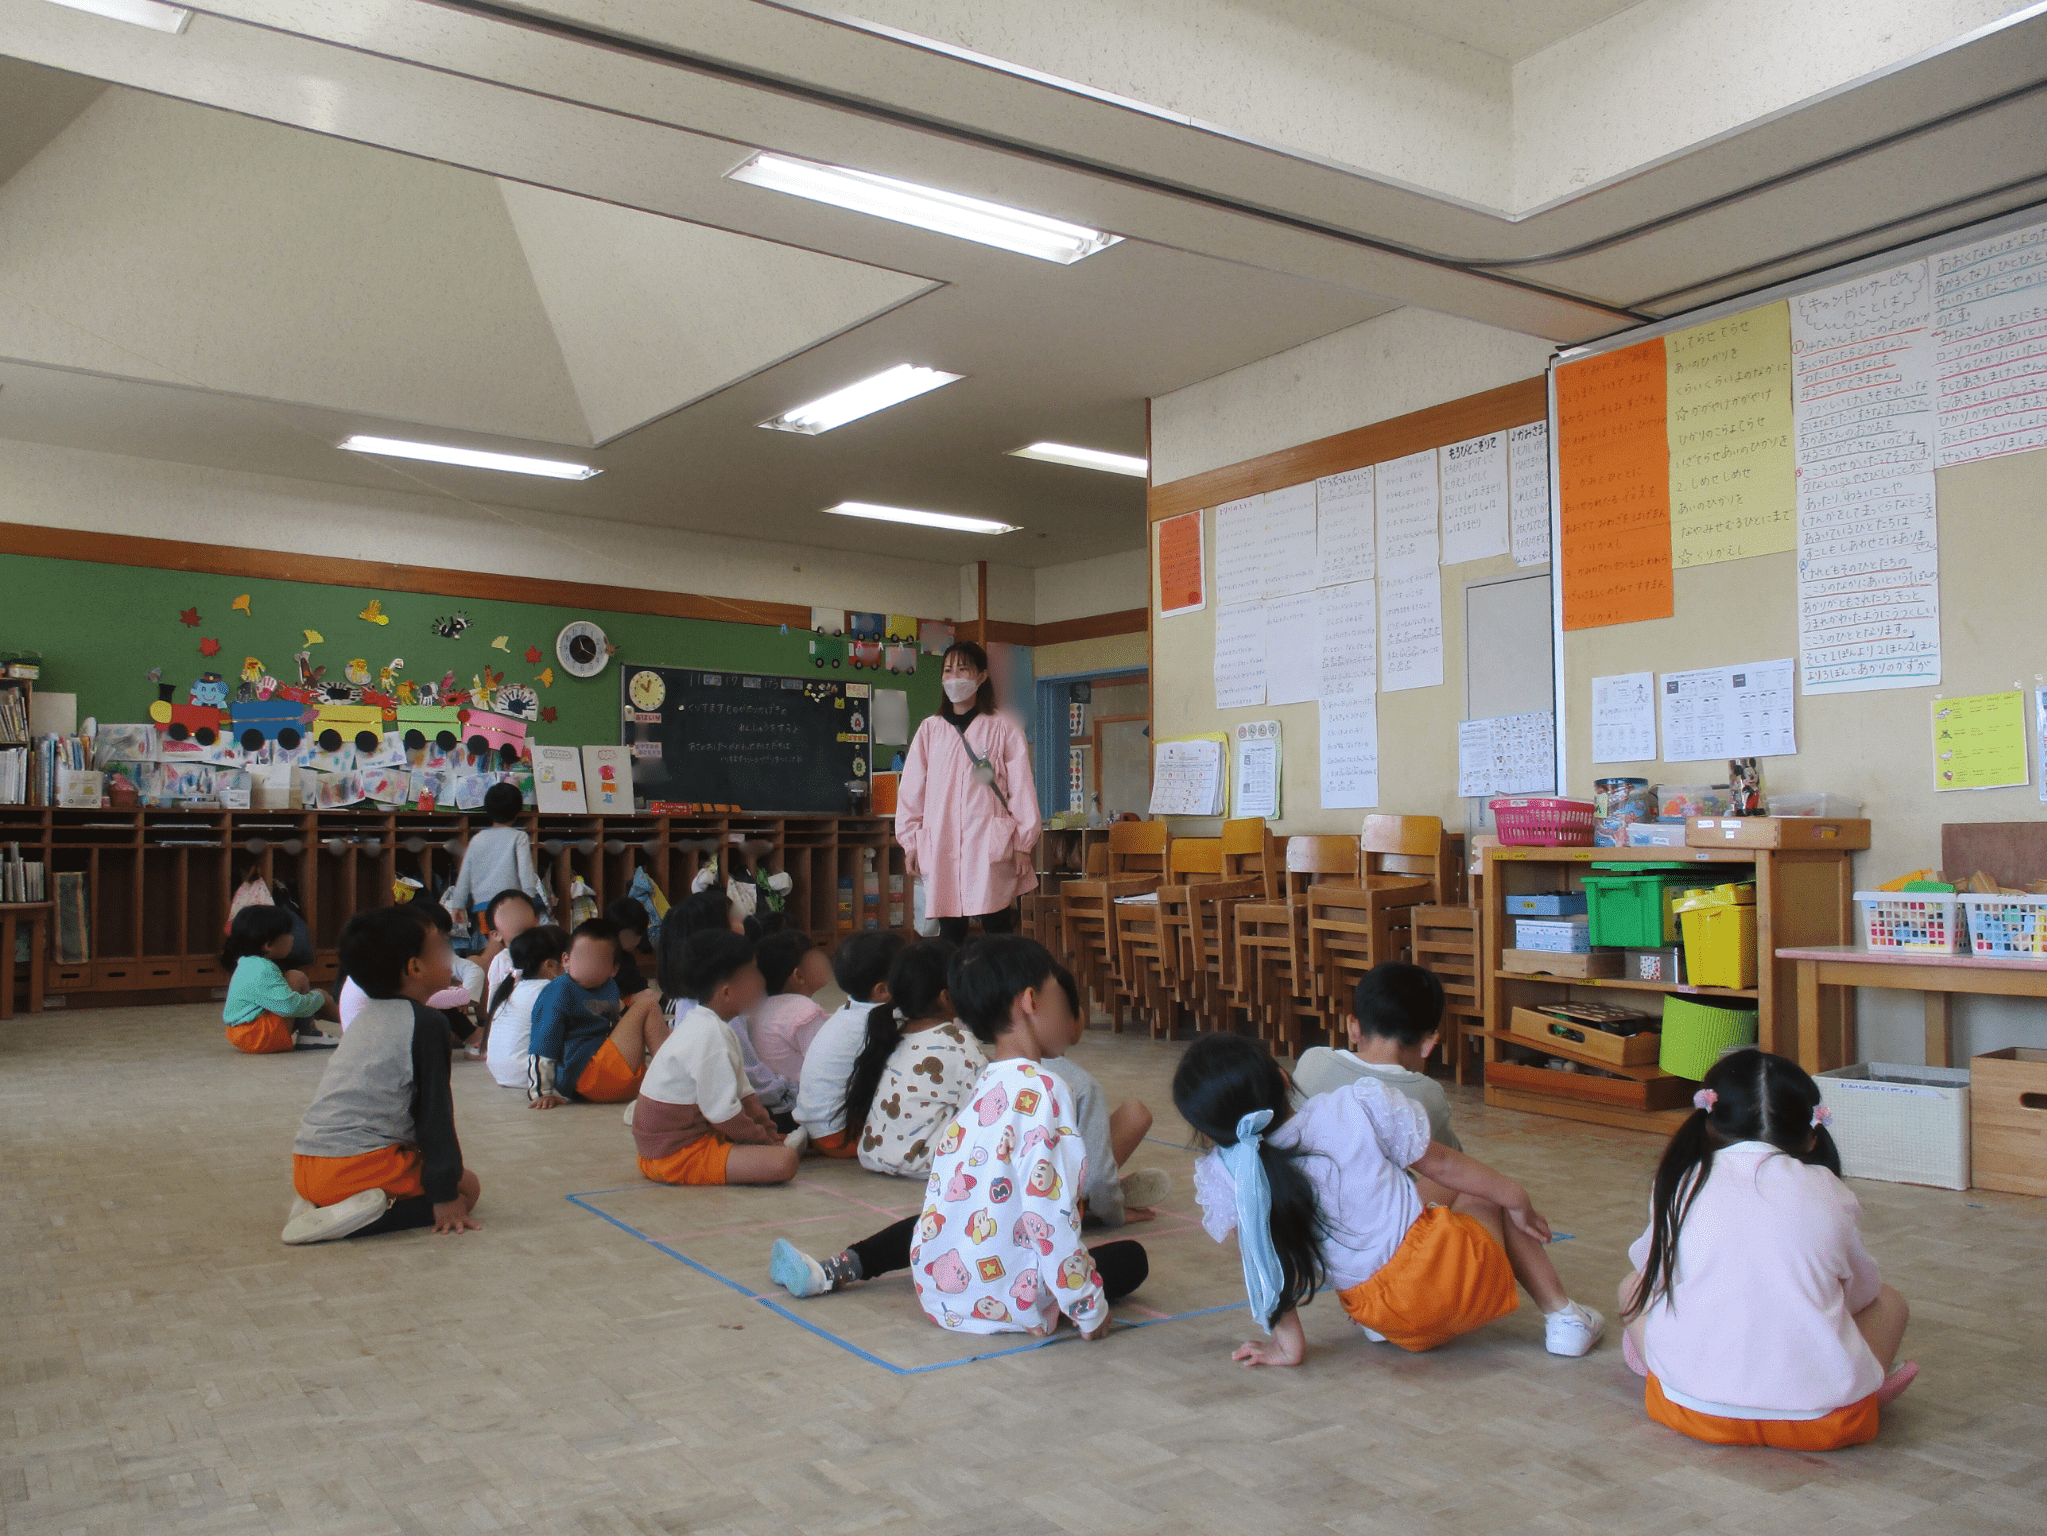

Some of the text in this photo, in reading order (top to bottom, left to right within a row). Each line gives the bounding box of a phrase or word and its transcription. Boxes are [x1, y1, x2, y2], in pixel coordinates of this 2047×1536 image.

[1809, 271, 1913, 313] キャンドルサービス
[1843, 291, 1903, 321] のことば
[1448, 436, 1497, 460] もろびとこぞりて
